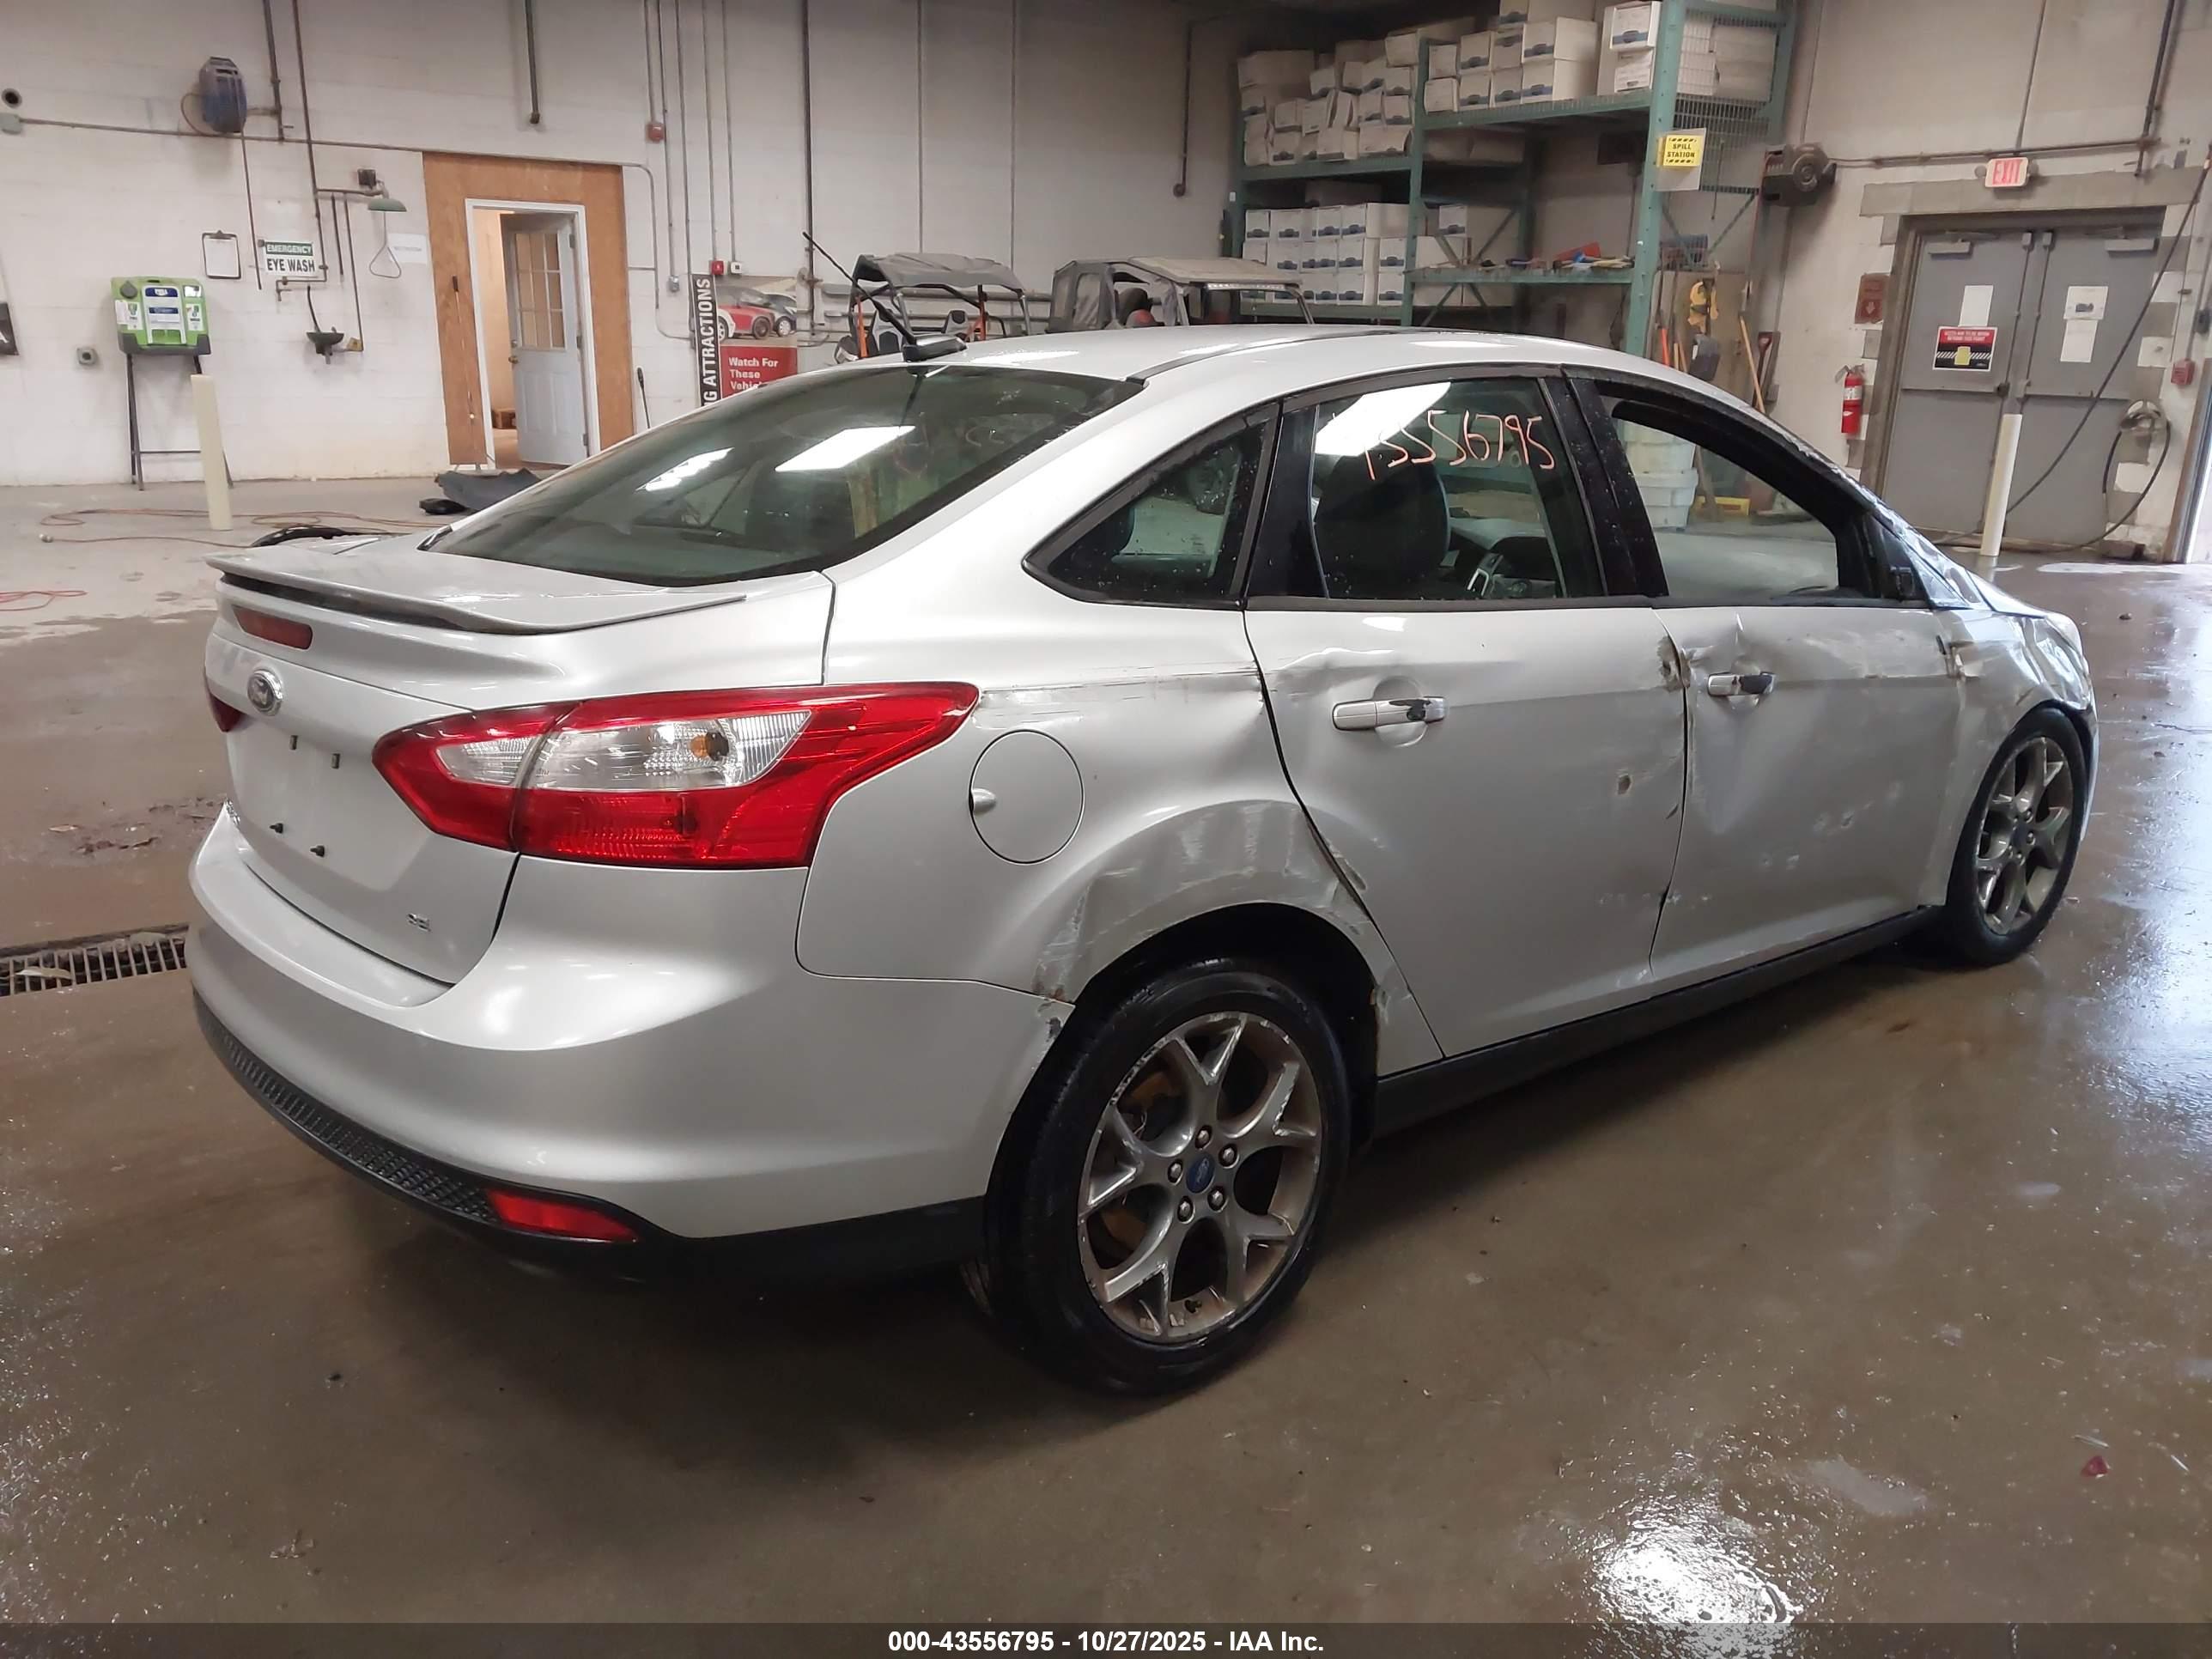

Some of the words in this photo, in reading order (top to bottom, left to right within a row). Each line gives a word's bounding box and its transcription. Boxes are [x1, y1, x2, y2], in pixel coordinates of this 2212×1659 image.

[1992, 160, 2021, 185] EXIT
[267, 258, 285, 271] EYE
[288, 258, 315, 272] WASH
[696, 278, 717, 386] ATTRACTIONS
[728, 356, 760, 367] Watch
[762, 357, 779, 368] For
[729, 369, 761, 379] These
